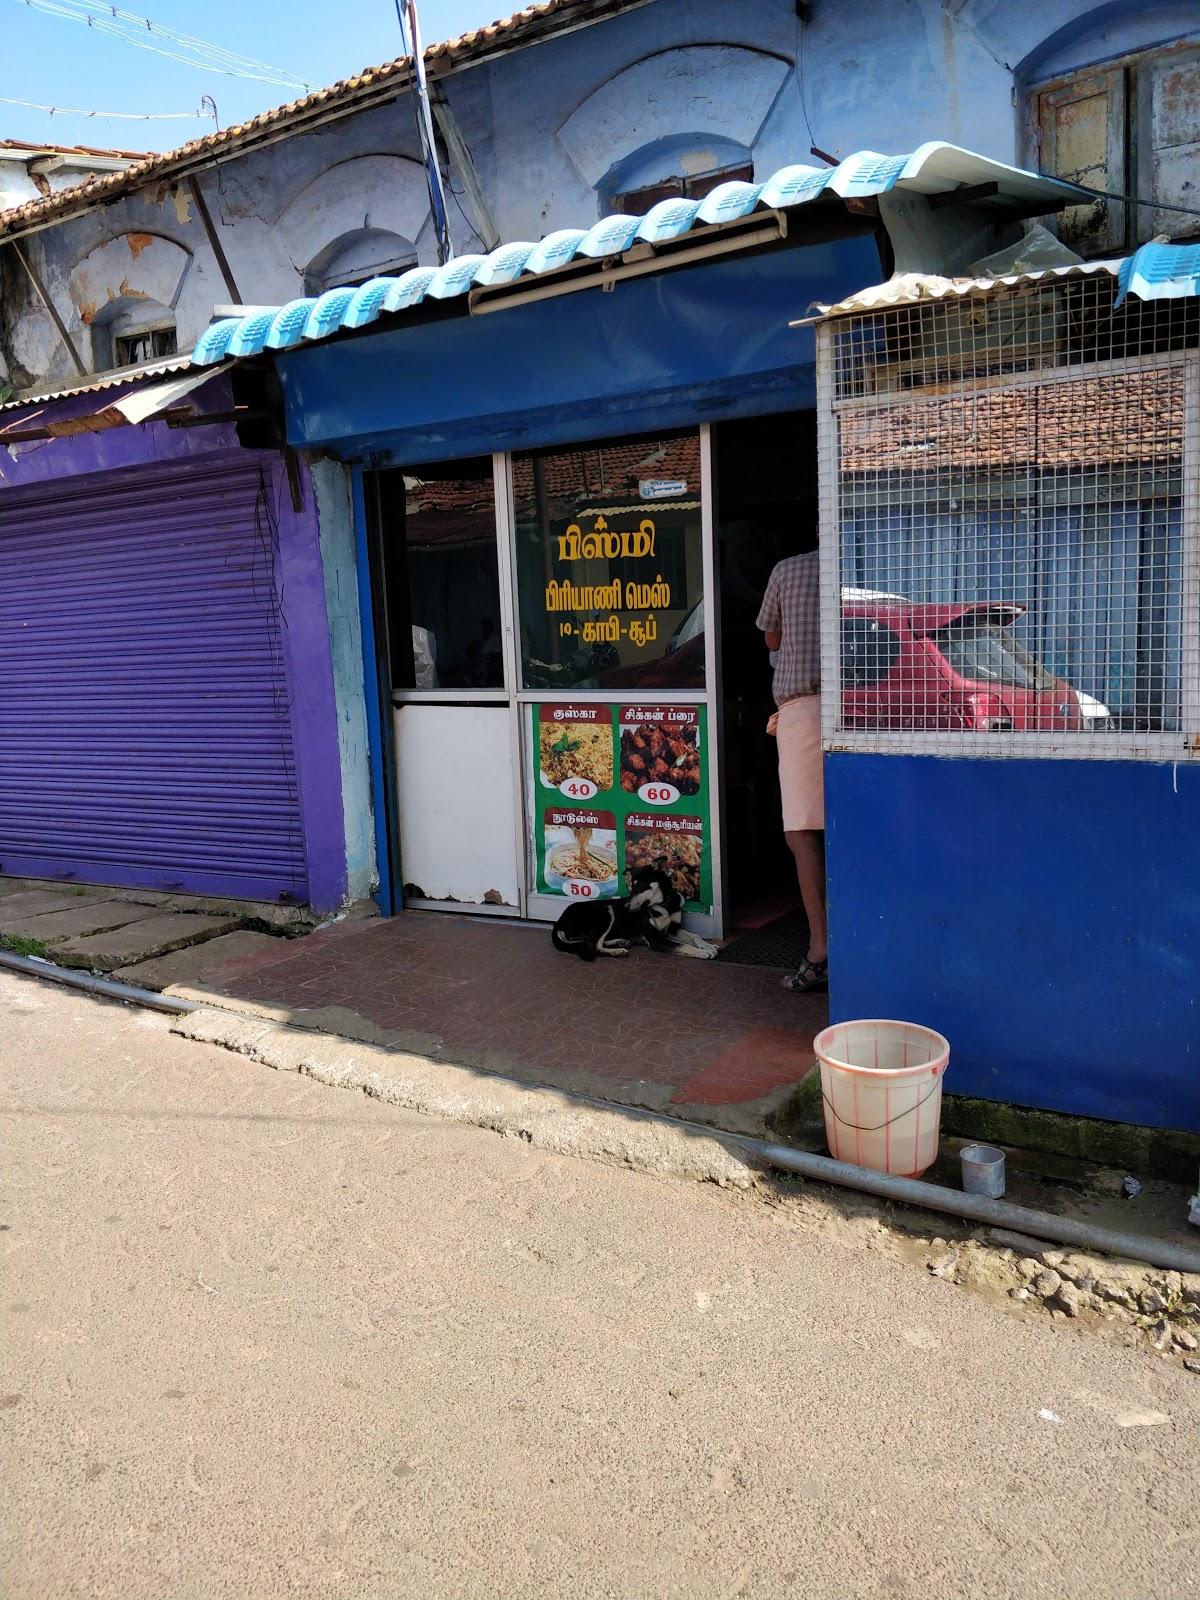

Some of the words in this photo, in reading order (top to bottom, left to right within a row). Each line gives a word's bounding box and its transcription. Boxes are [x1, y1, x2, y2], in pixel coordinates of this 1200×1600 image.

[558, 515, 656, 561] பிஸ்மி
[545, 578, 623, 611] பிரியாணி
[625, 574, 671, 610] மெஸ்
[553, 705, 597, 720] குஸ்கா
[625, 707, 665, 721] சிக்கன்
[667, 708, 696, 724] ப்ரை
[568, 783, 591, 796] 40
[647, 788, 671, 801] 60
[552, 810, 599, 825] நூடுல்ஸ்
[626, 814, 654, 828] சிக்கன்
[570, 883, 592, 897] 50
